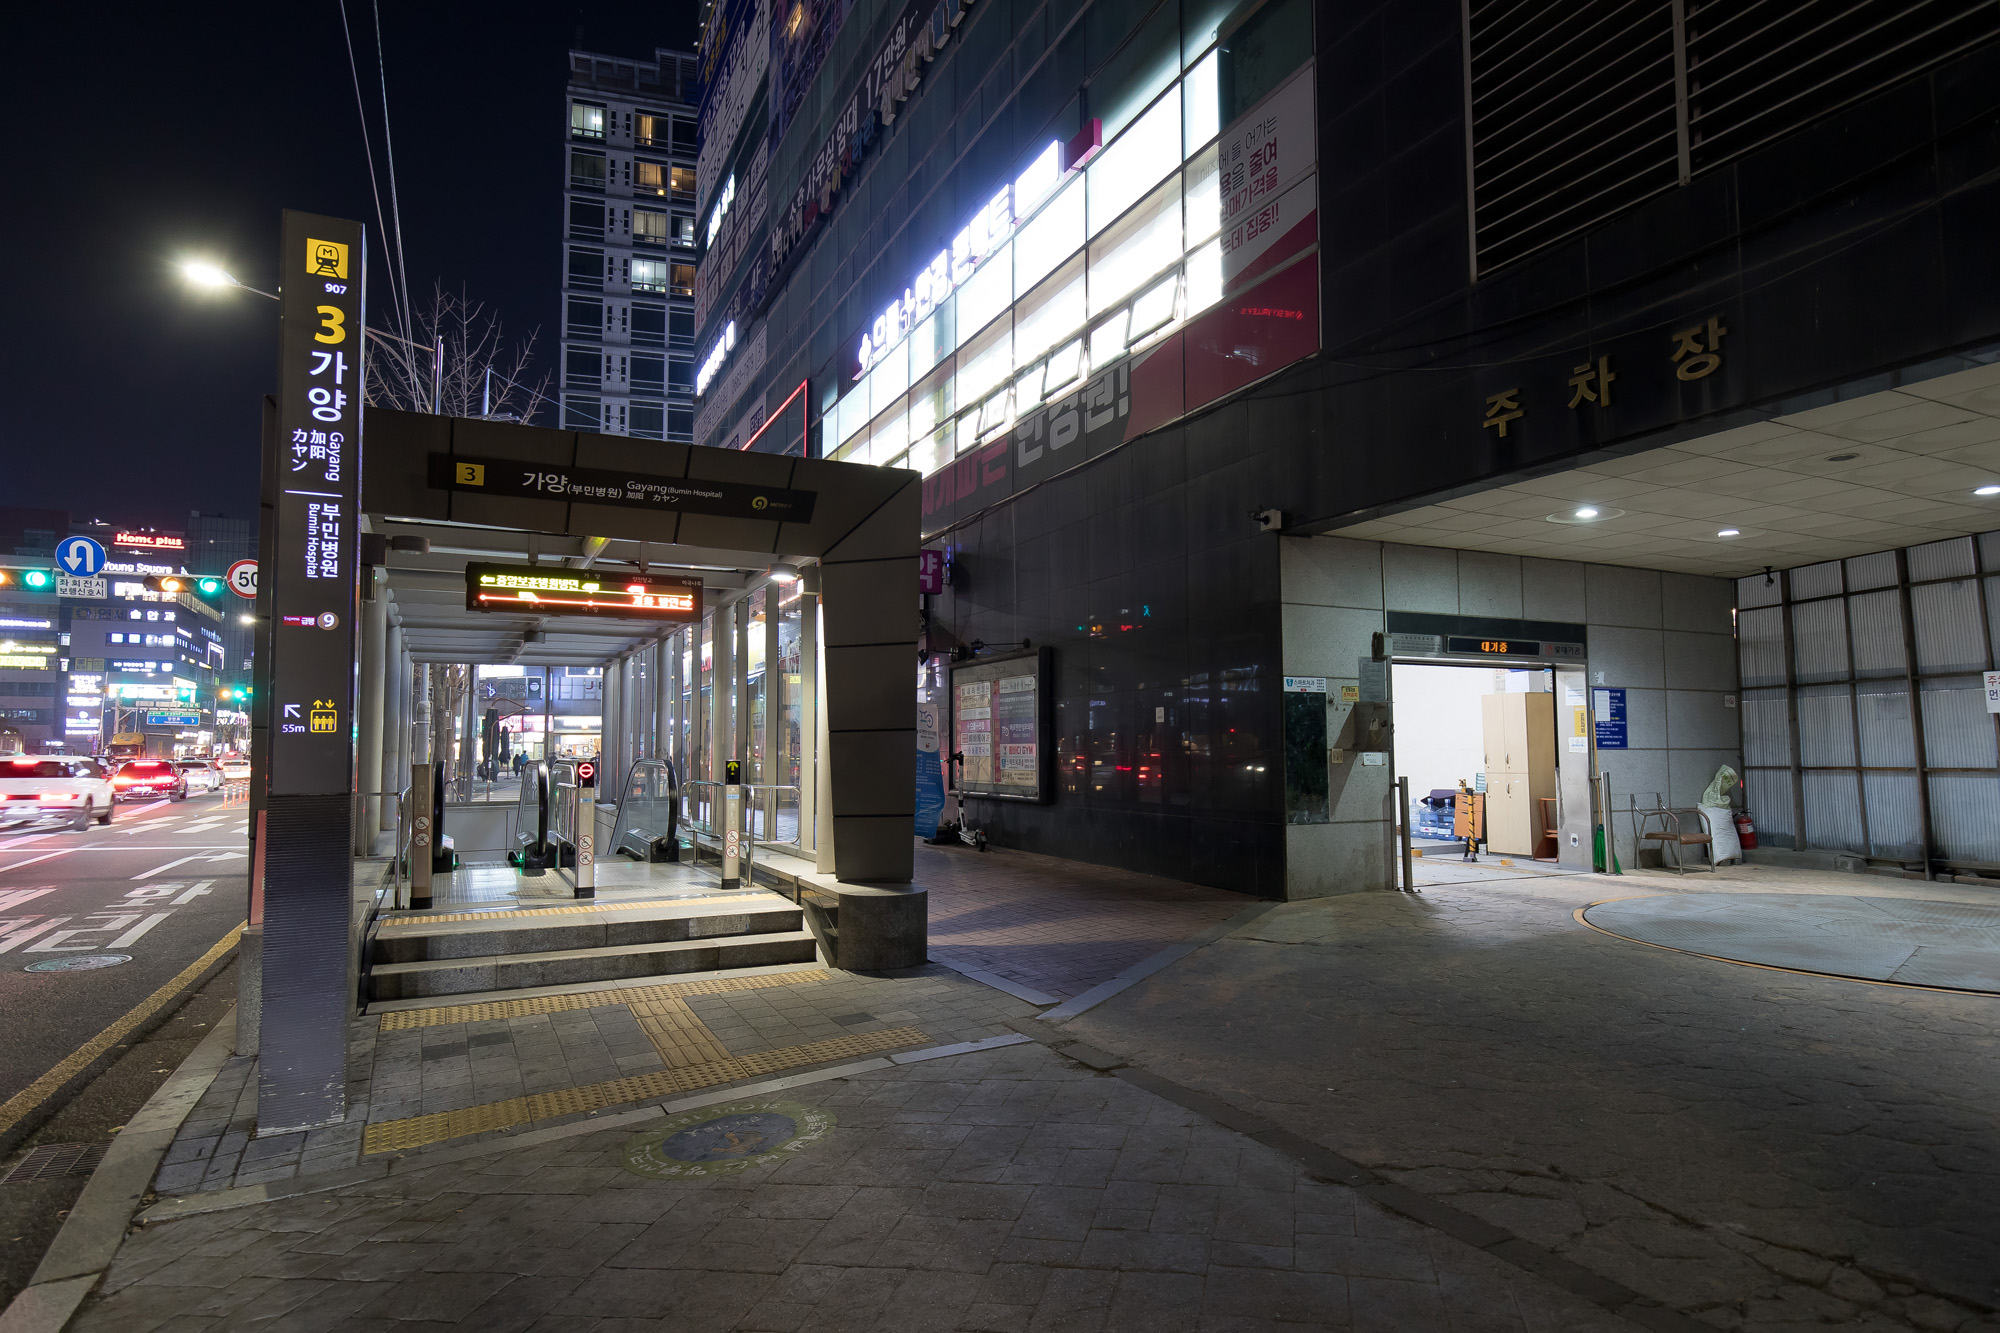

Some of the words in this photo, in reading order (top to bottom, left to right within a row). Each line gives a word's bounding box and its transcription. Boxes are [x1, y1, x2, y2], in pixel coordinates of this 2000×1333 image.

[837, 95, 857, 156] 임대
[807, 139, 835, 199] 사무실
[1219, 161, 1244, 200] 용을
[1249, 136, 1278, 179] 줄여
[1247, 202, 1279, 242] 집중!!
[325, 283, 347, 295] 907
[314, 305, 346, 345] 3
[1483, 315, 1728, 438] 주차장
[308, 351, 348, 422] 가양
[291, 428, 308, 472] カヤン
[309, 429, 326, 460] 加阳
[325, 432, 344, 482] Gayang
[463, 467, 477, 482] 3
[522, 472, 568, 493] 가양
[567, 483, 623, 500] (부민병원)
[626, 480, 668, 496] Gayang
[667, 486, 692, 498] (Bumin
[692, 489, 723, 499] Hospital)
[653, 494, 680, 503] カヤン
[307, 503, 321, 536] Bumin
[156, 537, 182, 547] plus
[321, 503, 341, 578] 부민병원
[305, 536, 320, 578] Hospital
[137, 563, 173, 574] Square
[59, 579, 104, 588] 좌회전시
[238, 572, 258, 588] 50
[59, 588, 104, 597] 보행신호시
[301, 617, 315, 626] 급행
[323, 614, 335, 628] 9
[1481, 641, 1508, 653] 대기중
[1294, 679, 1315, 687] 스마트치과
[1988, 675, 2000, 687] 주
[1989, 689, 2000, 701] 먼
[282, 724, 305, 733] 55m
